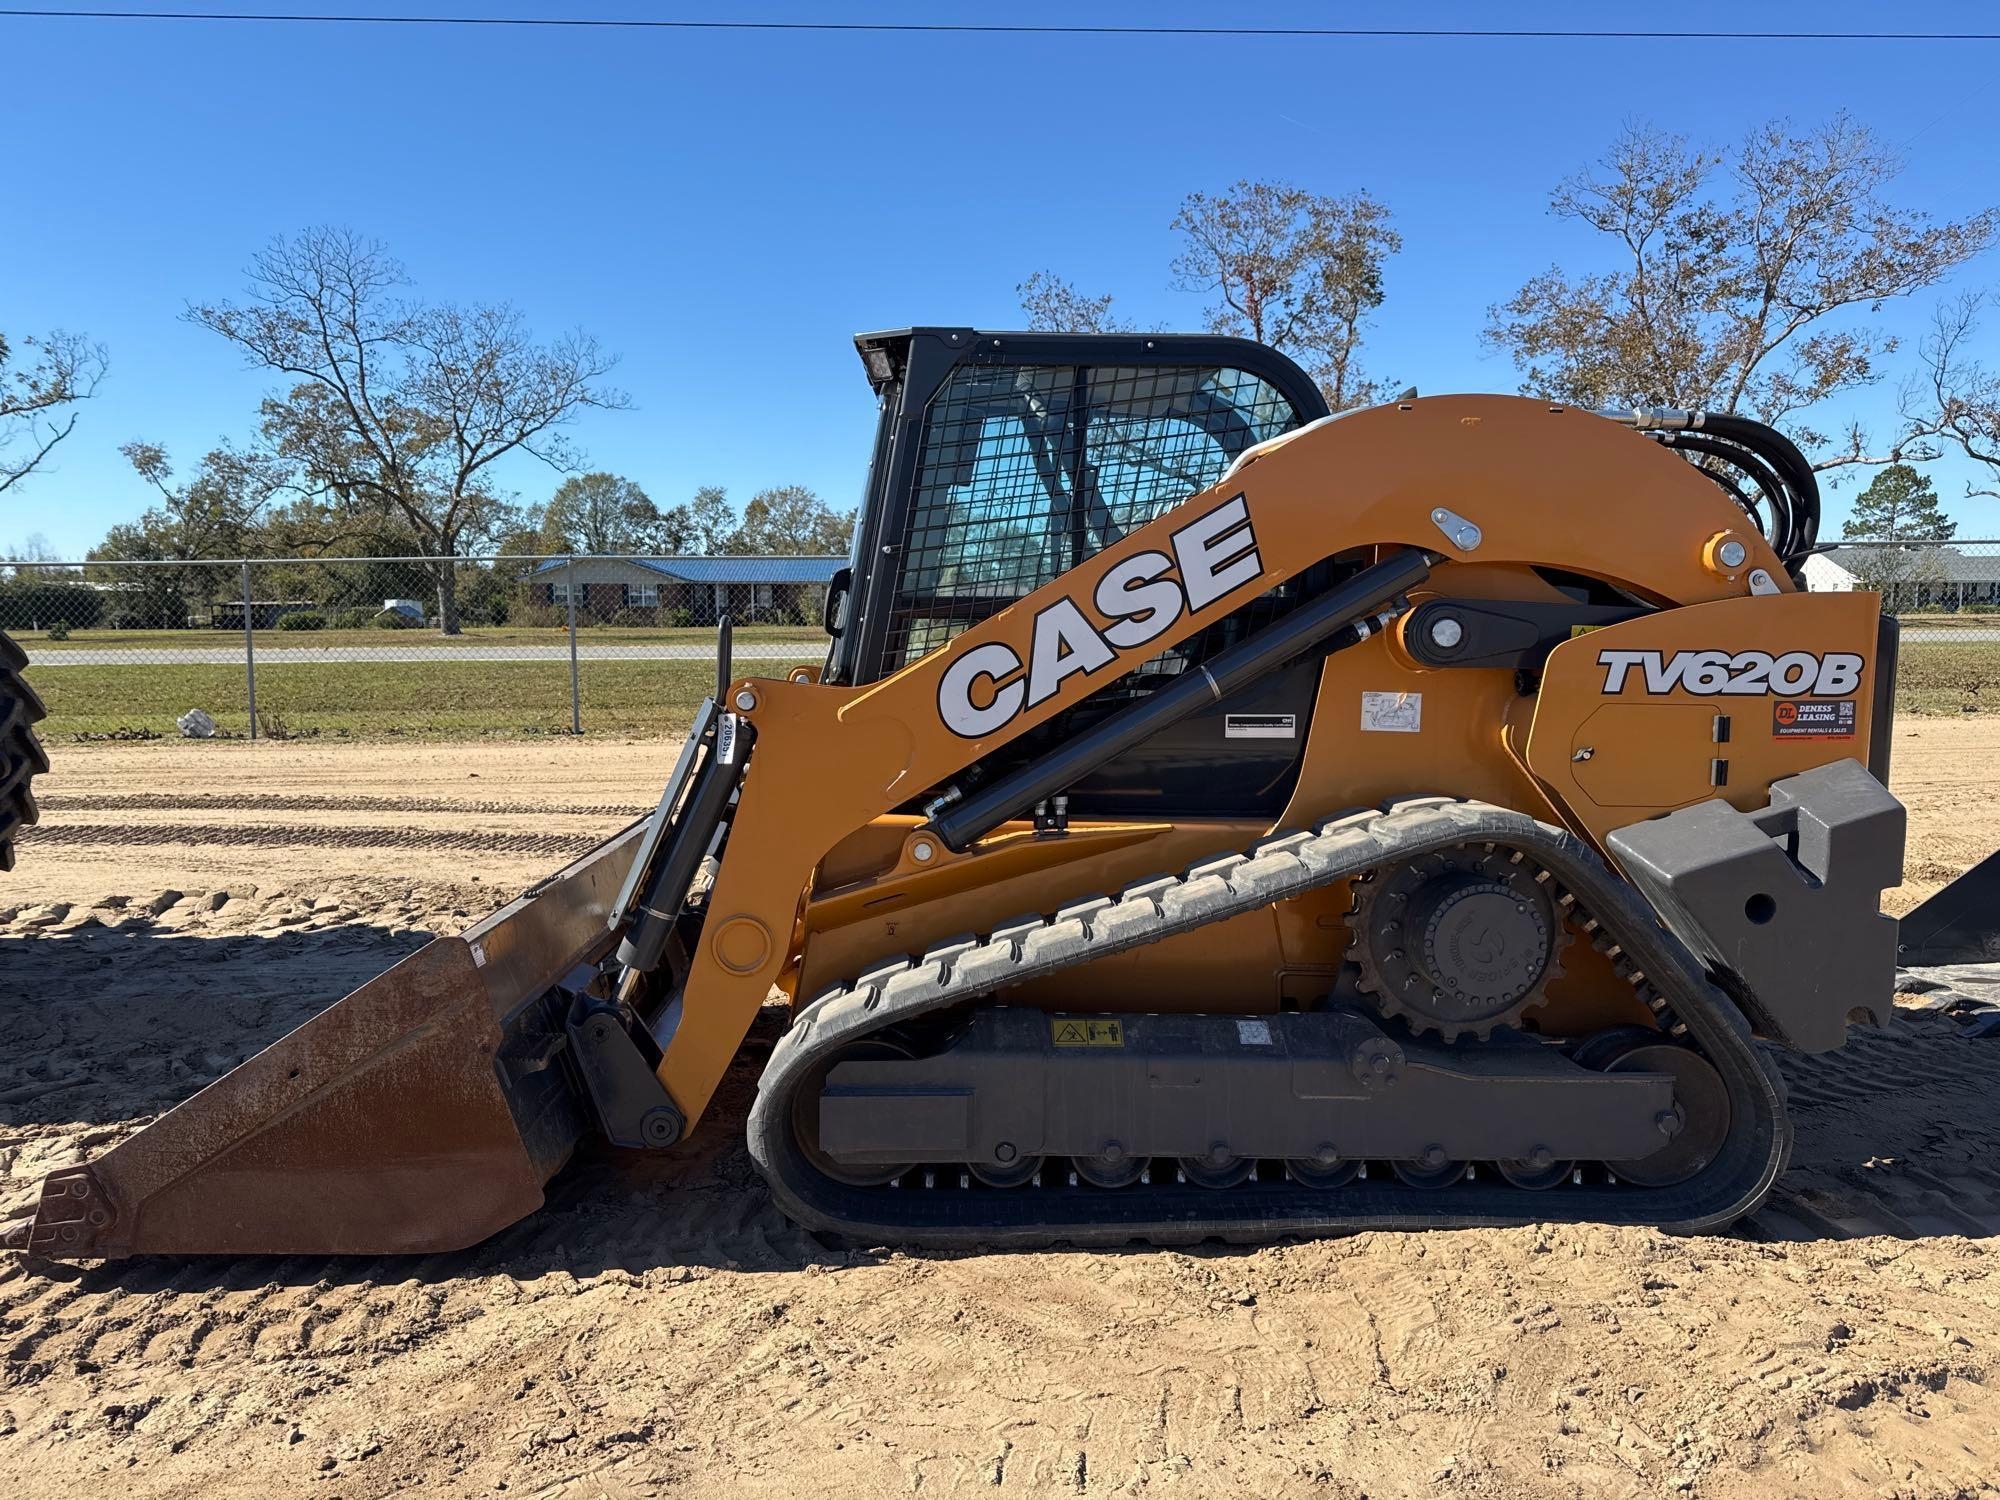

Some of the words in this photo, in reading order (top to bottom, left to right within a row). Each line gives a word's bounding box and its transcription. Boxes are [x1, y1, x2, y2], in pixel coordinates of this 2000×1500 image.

[937, 492, 1264, 739] CASE
[1597, 650, 1864, 697] TV620B
[1797, 713, 1836, 721] LEASING
[1799, 705, 1833, 713] DENESS
